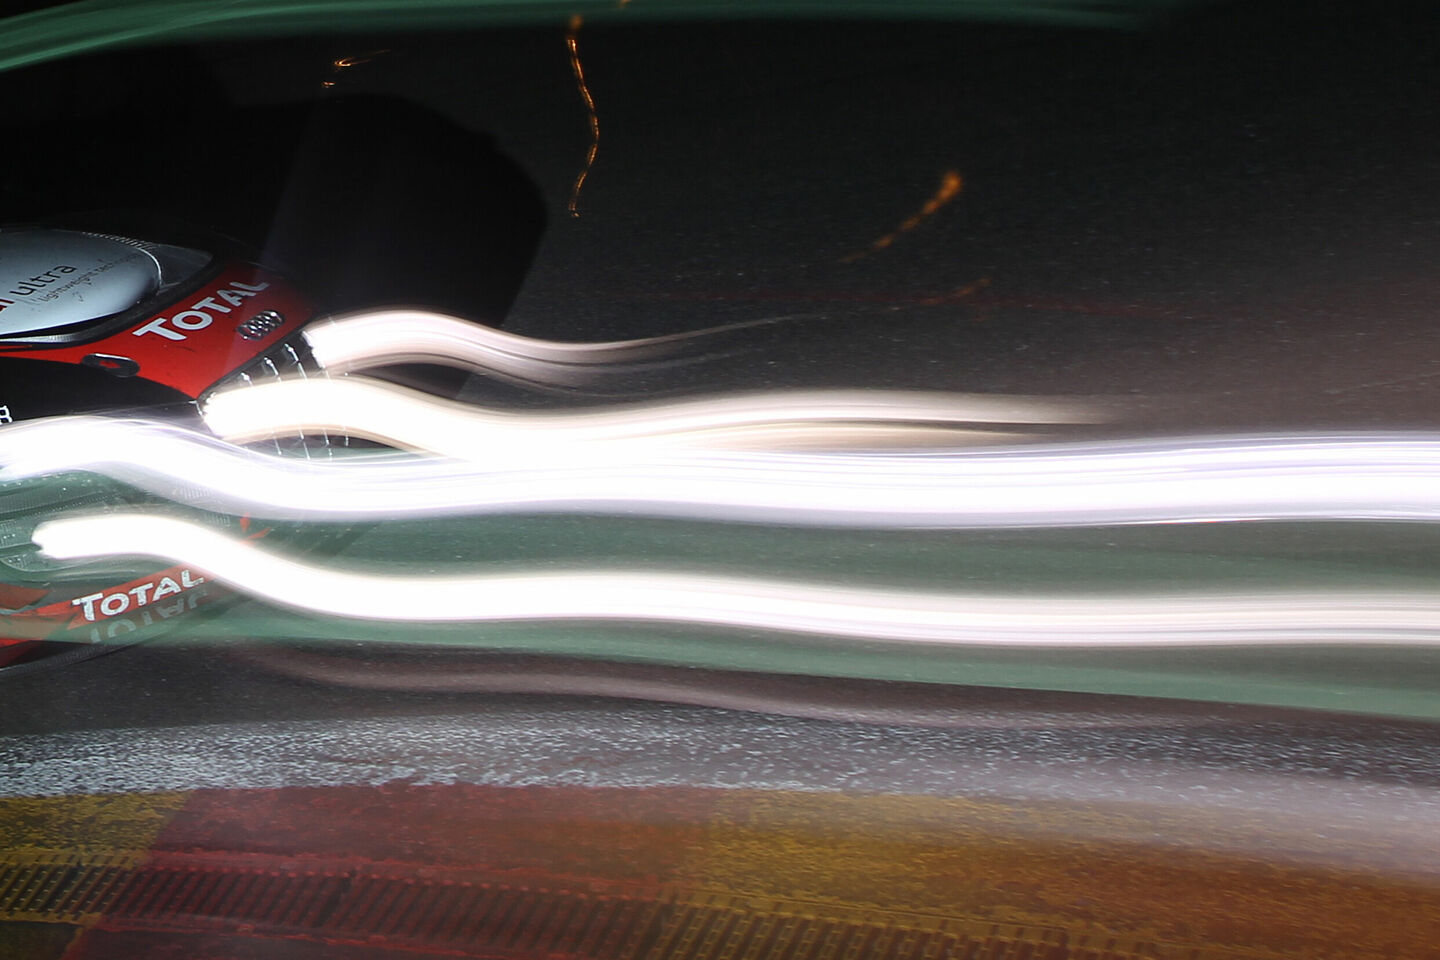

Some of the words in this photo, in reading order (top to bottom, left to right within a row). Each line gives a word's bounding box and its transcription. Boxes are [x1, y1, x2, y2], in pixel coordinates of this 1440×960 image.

[9, 265, 77, 296] ultra
[132, 279, 270, 341] TOTAL
[71, 568, 205, 622] TOTAL
